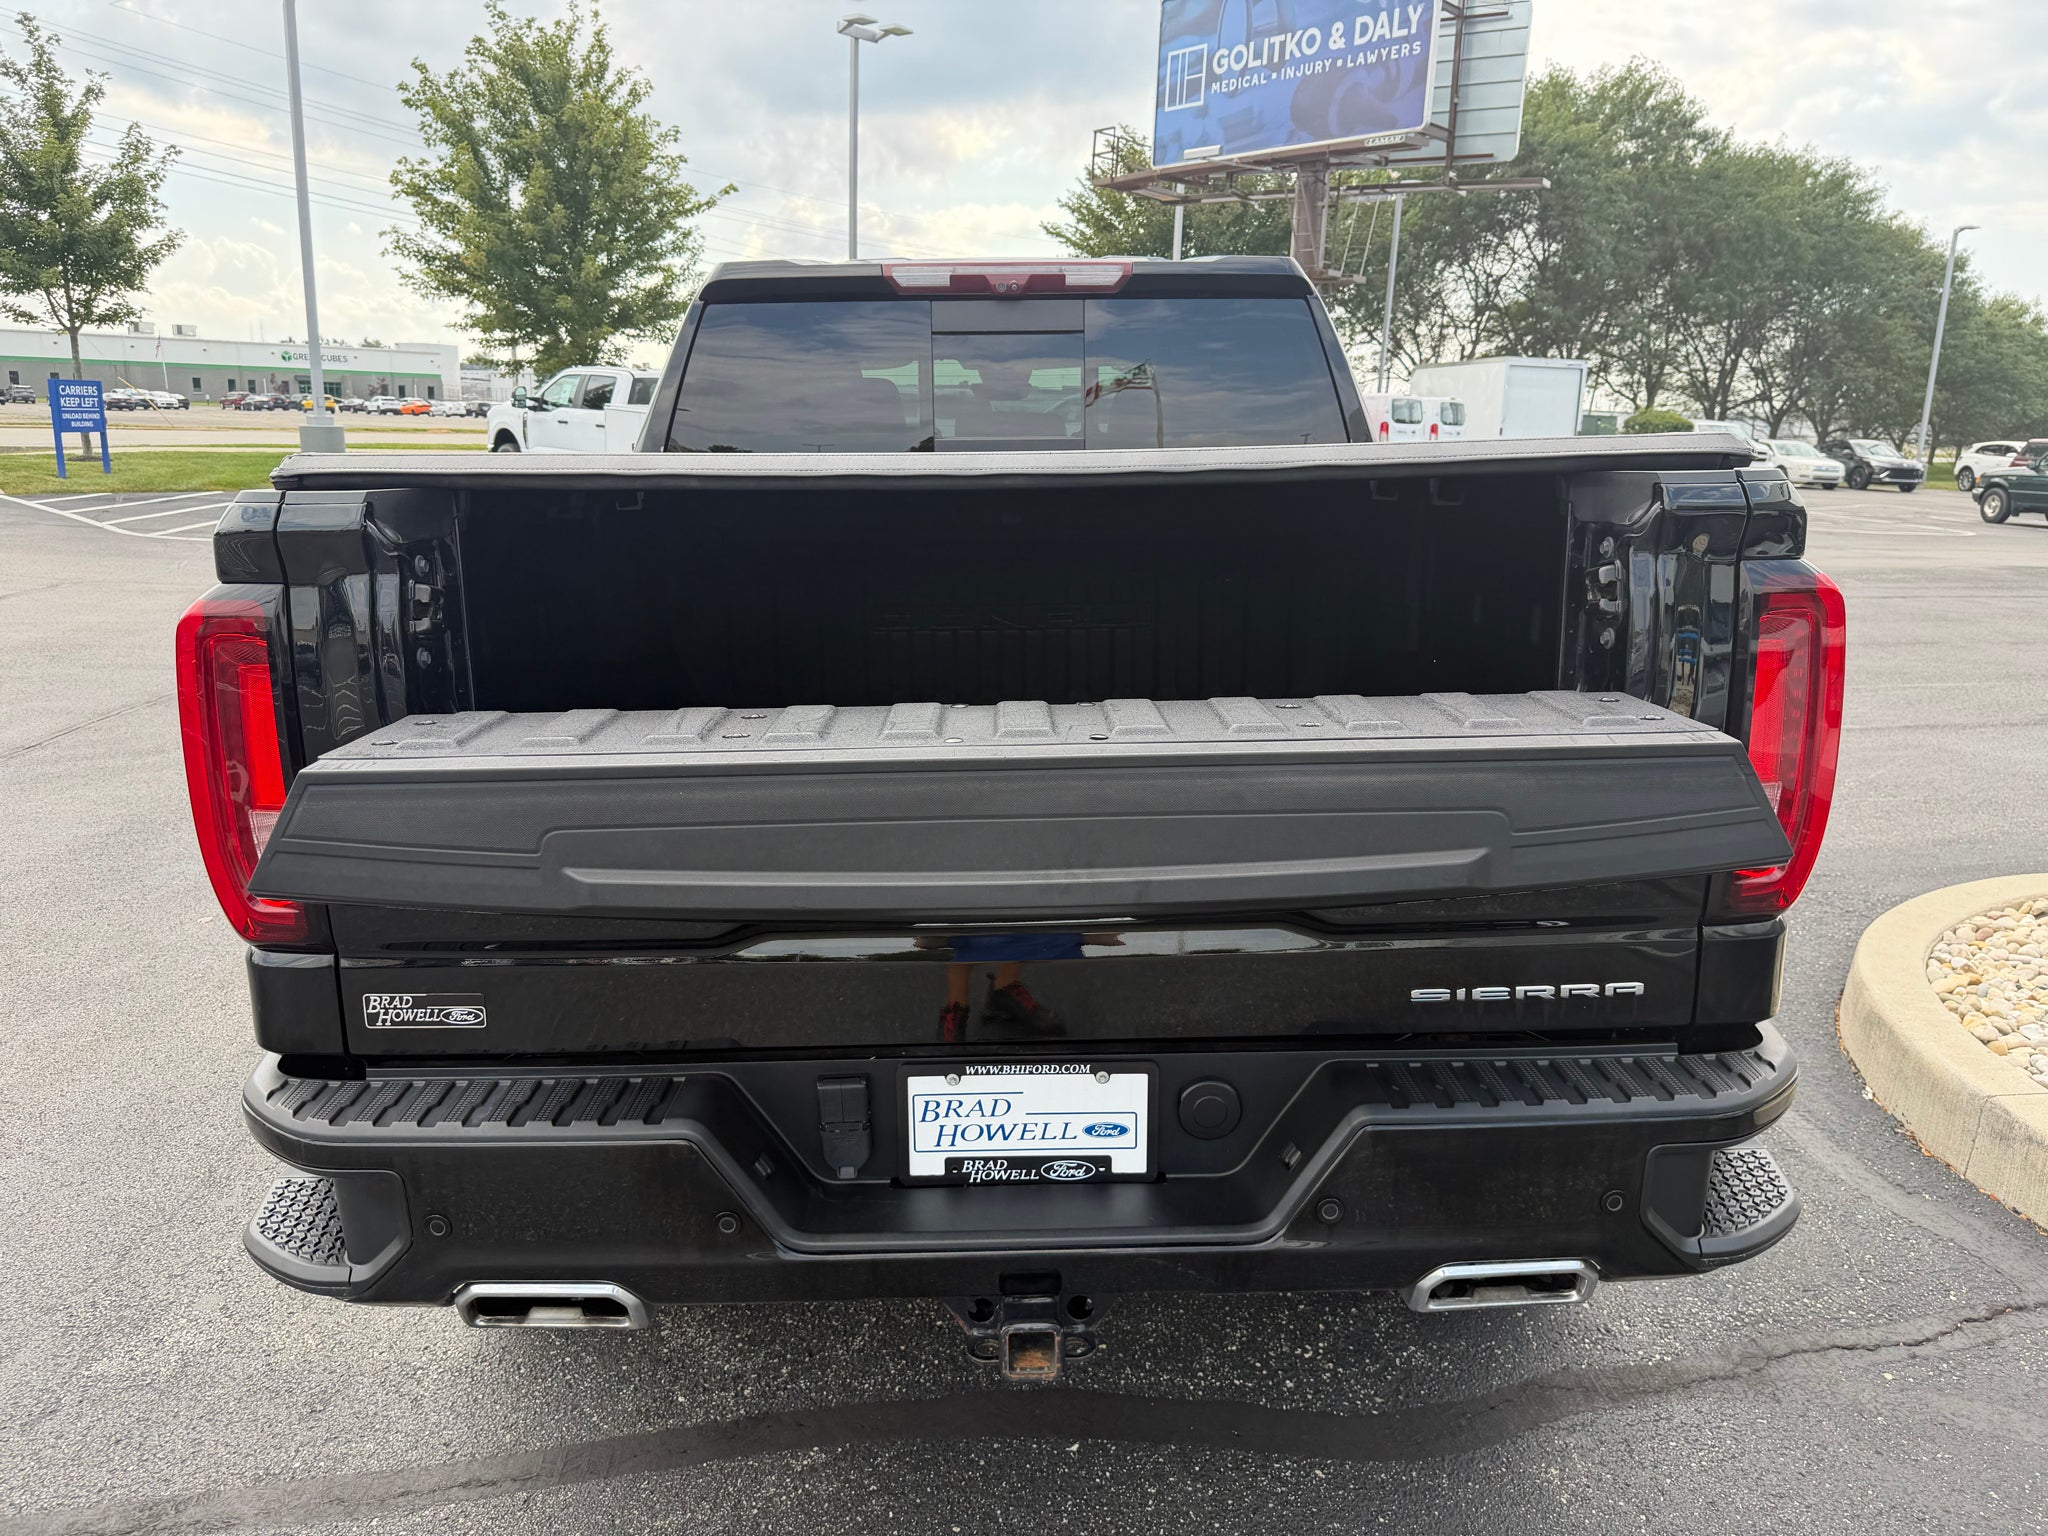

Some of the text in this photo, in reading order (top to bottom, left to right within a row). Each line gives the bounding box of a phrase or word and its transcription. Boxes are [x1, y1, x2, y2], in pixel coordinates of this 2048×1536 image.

[1212, 2, 1425, 75] GOLITKO & DALY
[1211, 41, 1422, 94] MEDICAL INJURY LAWYERS
[59, 385, 98, 396] CARRIERS
[60, 397, 98, 407] KEEP LEFT
[1410, 981, 1645, 1002] SIERRA
[367, 996, 413, 1013] BRAD
[376, 1009, 441, 1026] HOWELL
[965, 1064, 1091, 1075] WWW.BHIFORD.COM
[919, 1098, 1012, 1123] BRAD
[934, 1122, 1078, 1147] HOWELL
[961, 1160, 1008, 1173] BRAD
[968, 1160, 1086, 1183] HOWELL Ford
